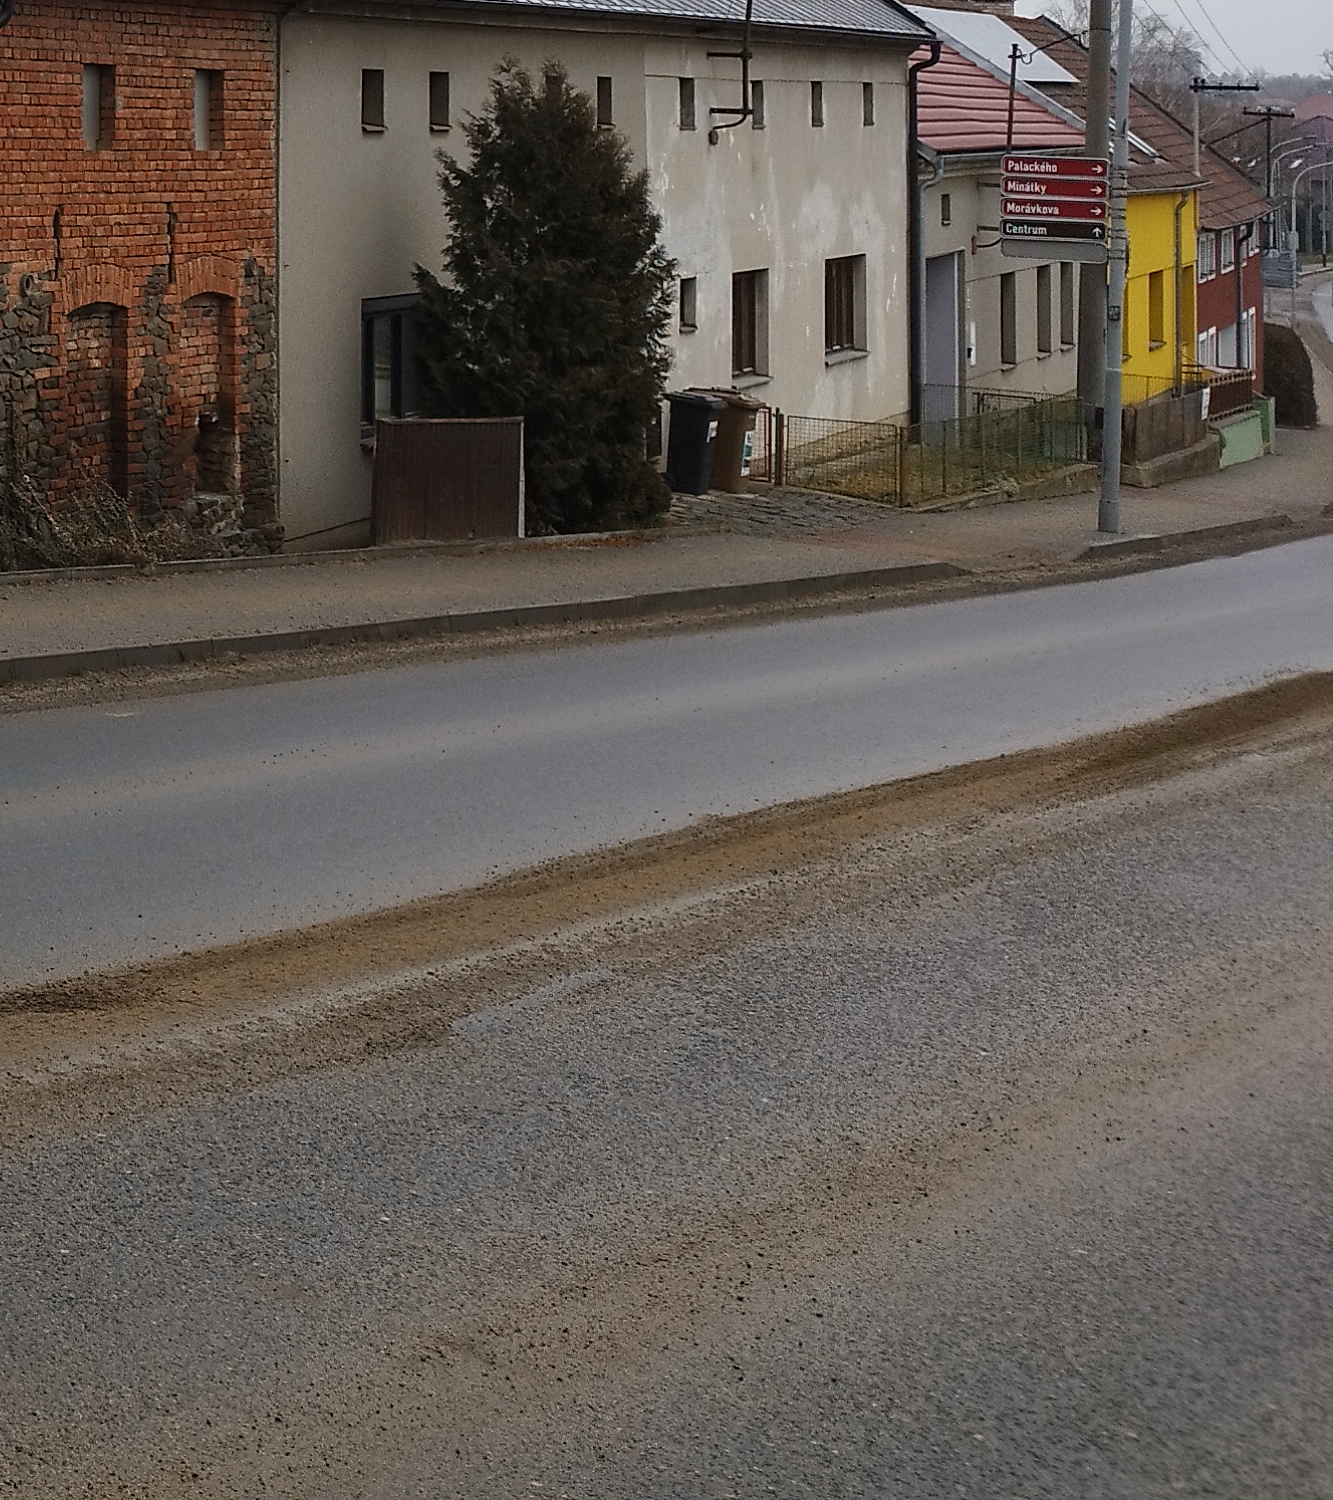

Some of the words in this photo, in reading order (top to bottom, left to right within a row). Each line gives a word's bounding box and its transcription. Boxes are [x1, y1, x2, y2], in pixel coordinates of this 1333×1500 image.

[1007, 160, 1058, 173] Palackého
[1007, 181, 1047, 195] Minátky
[1006, 202, 1060, 215] Morávkova
[1005, 223, 1048, 235] Centrum
